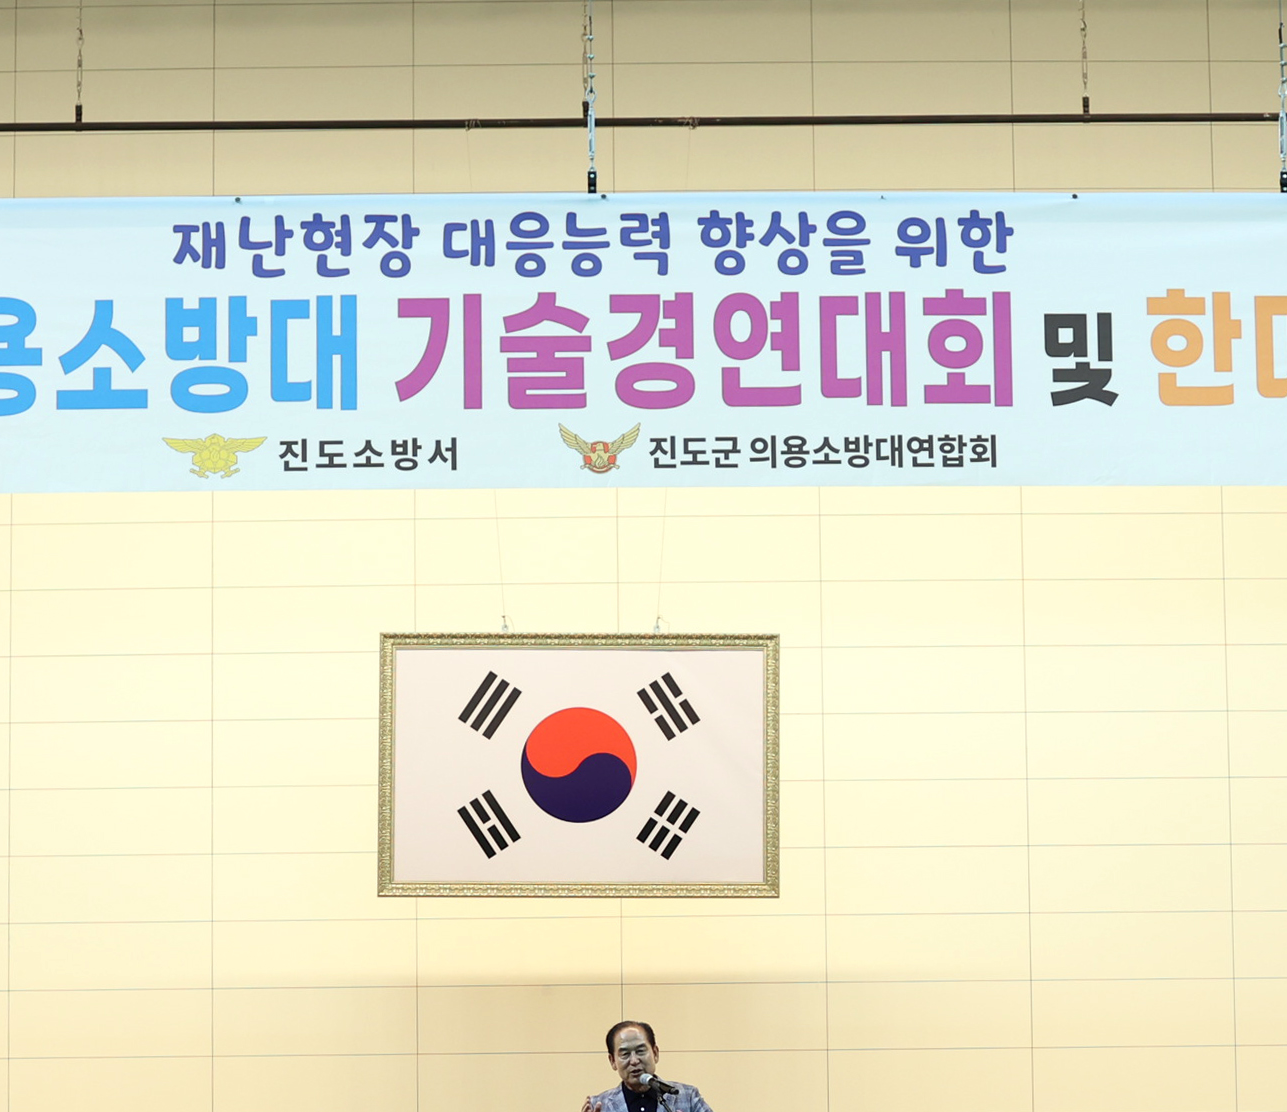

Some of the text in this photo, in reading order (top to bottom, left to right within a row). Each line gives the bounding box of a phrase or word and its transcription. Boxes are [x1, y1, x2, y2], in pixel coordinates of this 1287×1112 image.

[172, 209, 1014, 278] 재난현장 대응능력 향상을 위한
[395, 289, 1013, 410] 기술경연대회
[1044, 313, 1119, 407] 및
[278, 437, 457, 472] 진도소방서
[649, 434, 997, 469] 진도군 의용소방대연합회
